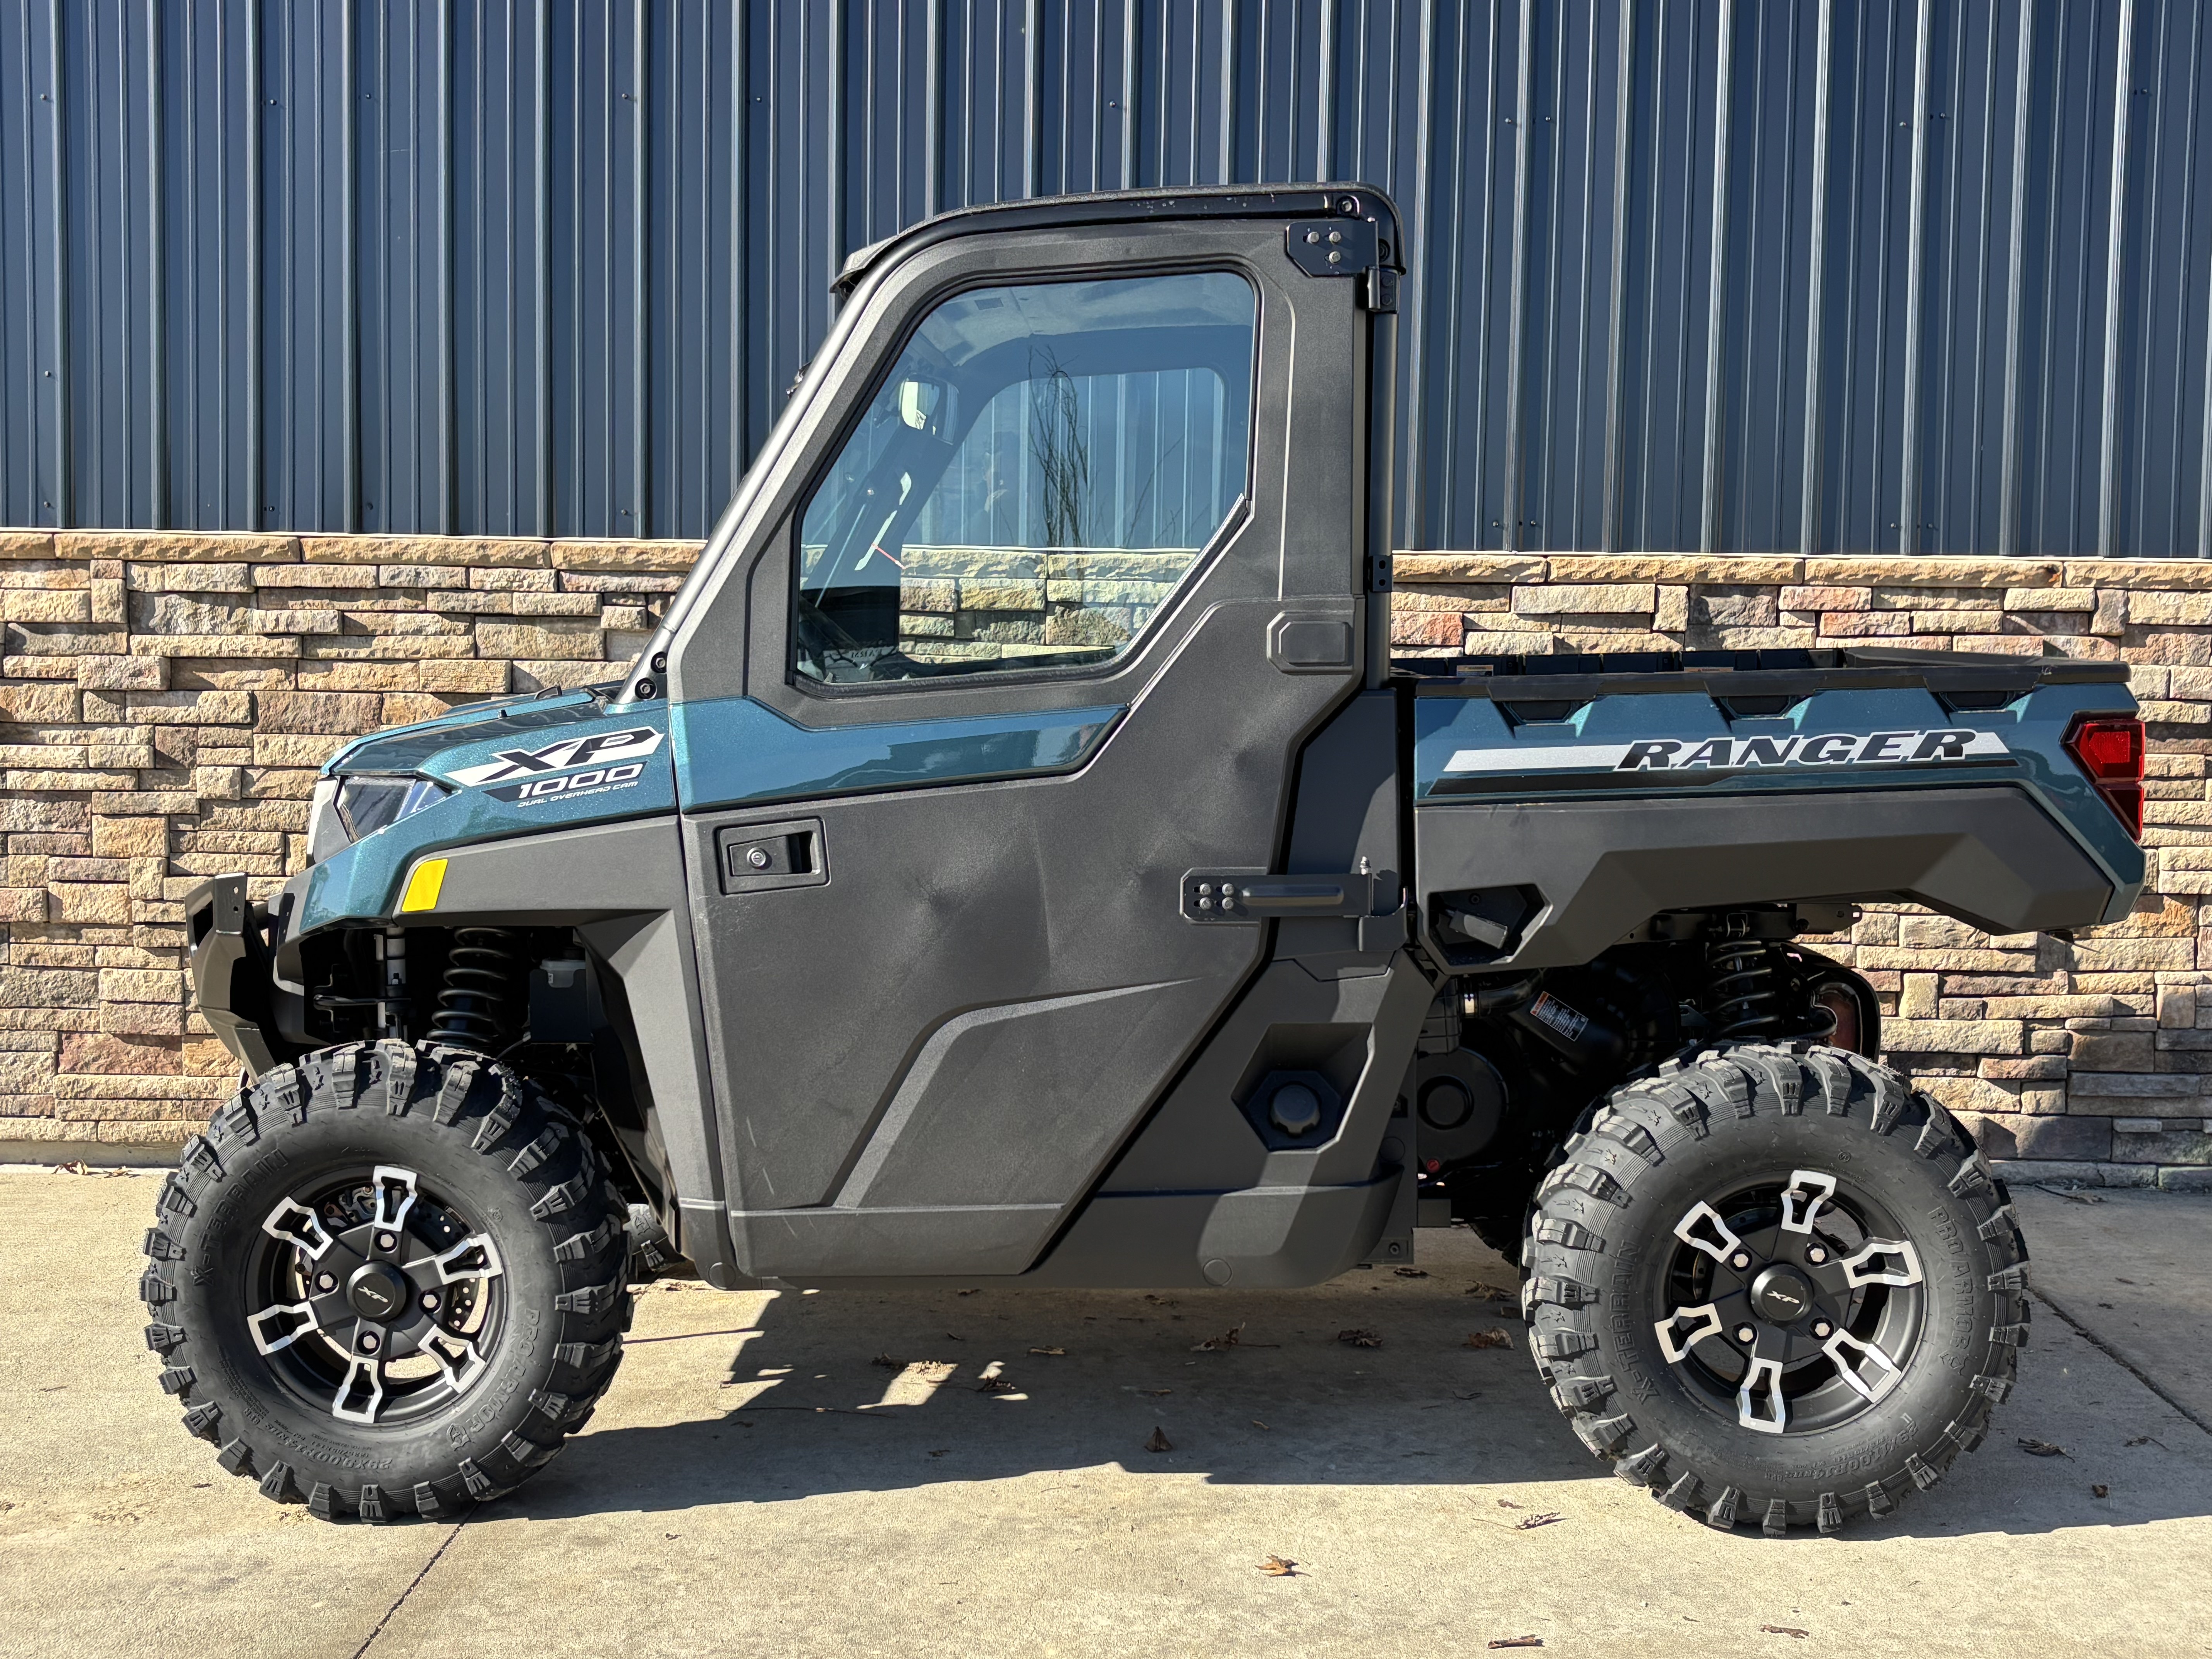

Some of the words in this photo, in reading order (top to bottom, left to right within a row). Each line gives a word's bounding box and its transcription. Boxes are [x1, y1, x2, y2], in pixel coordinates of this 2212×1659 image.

[475, 728, 656, 783] XP
[1617, 731, 1978, 770] RANGER
[516, 797, 548, 808] DUAL
[550, 785, 611, 802] OVERHEAD
[612, 781, 639, 791] CAM
[518, 763, 643, 799] 1000
[193, 1148, 289, 1286] X-TERRAIN
[357, 1286, 388, 1302] XP
[1767, 1290, 1800, 1304] XP
[1927, 1205, 1963, 1254] PRO
[1949, 1254, 1973, 1351] ARMOR
[516, 1307, 541, 1358] PRO
[1609, 1240, 1660, 1408] X-TERRAIN
[463, 1357, 529, 1436] ARMOR
